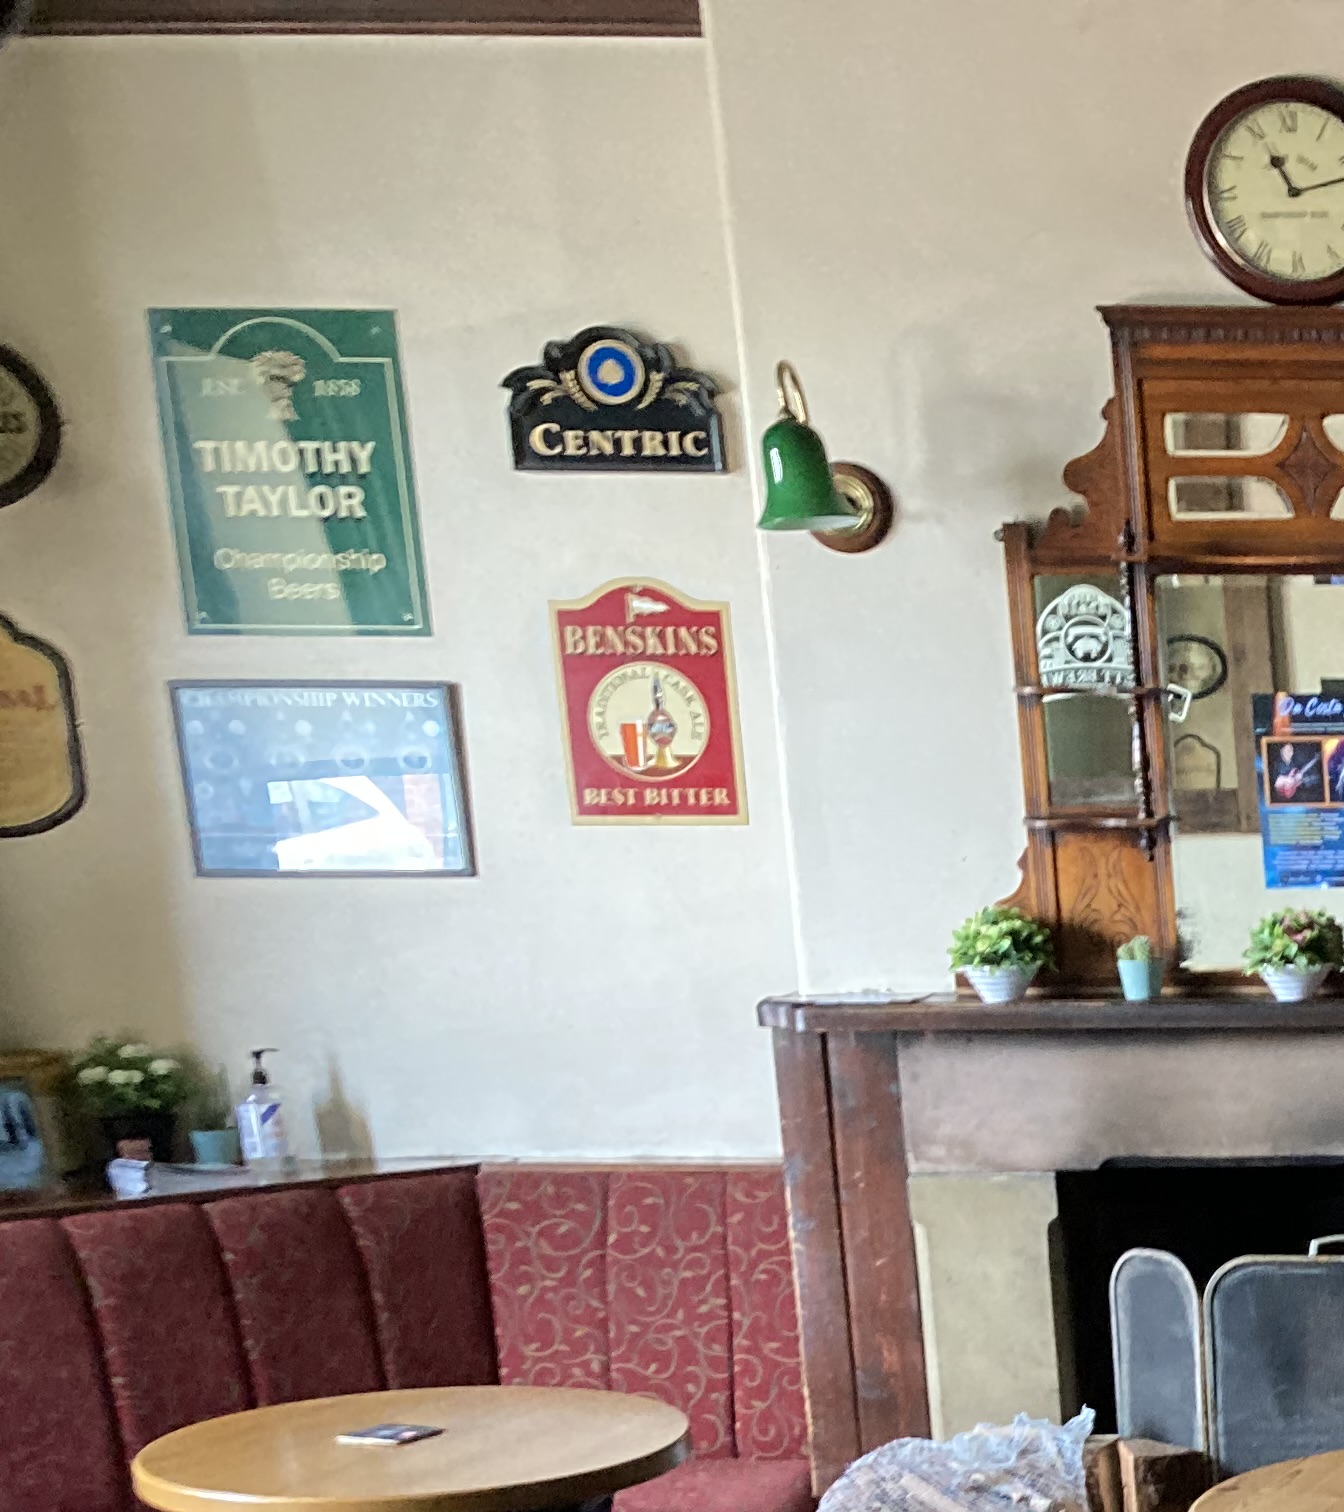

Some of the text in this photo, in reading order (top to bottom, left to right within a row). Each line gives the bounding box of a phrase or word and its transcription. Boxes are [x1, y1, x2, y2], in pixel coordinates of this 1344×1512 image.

[192, 439, 376, 475] TIMOTHY
[215, 484, 368, 519] TAYLOR
[213, 547, 387, 574] Championship
[267, 576, 341, 600] Beers
[563, 624, 719, 657] BENSKINS
[341, 691, 440, 709] WINNERS
[583, 786, 732, 807] BEST BITTER
